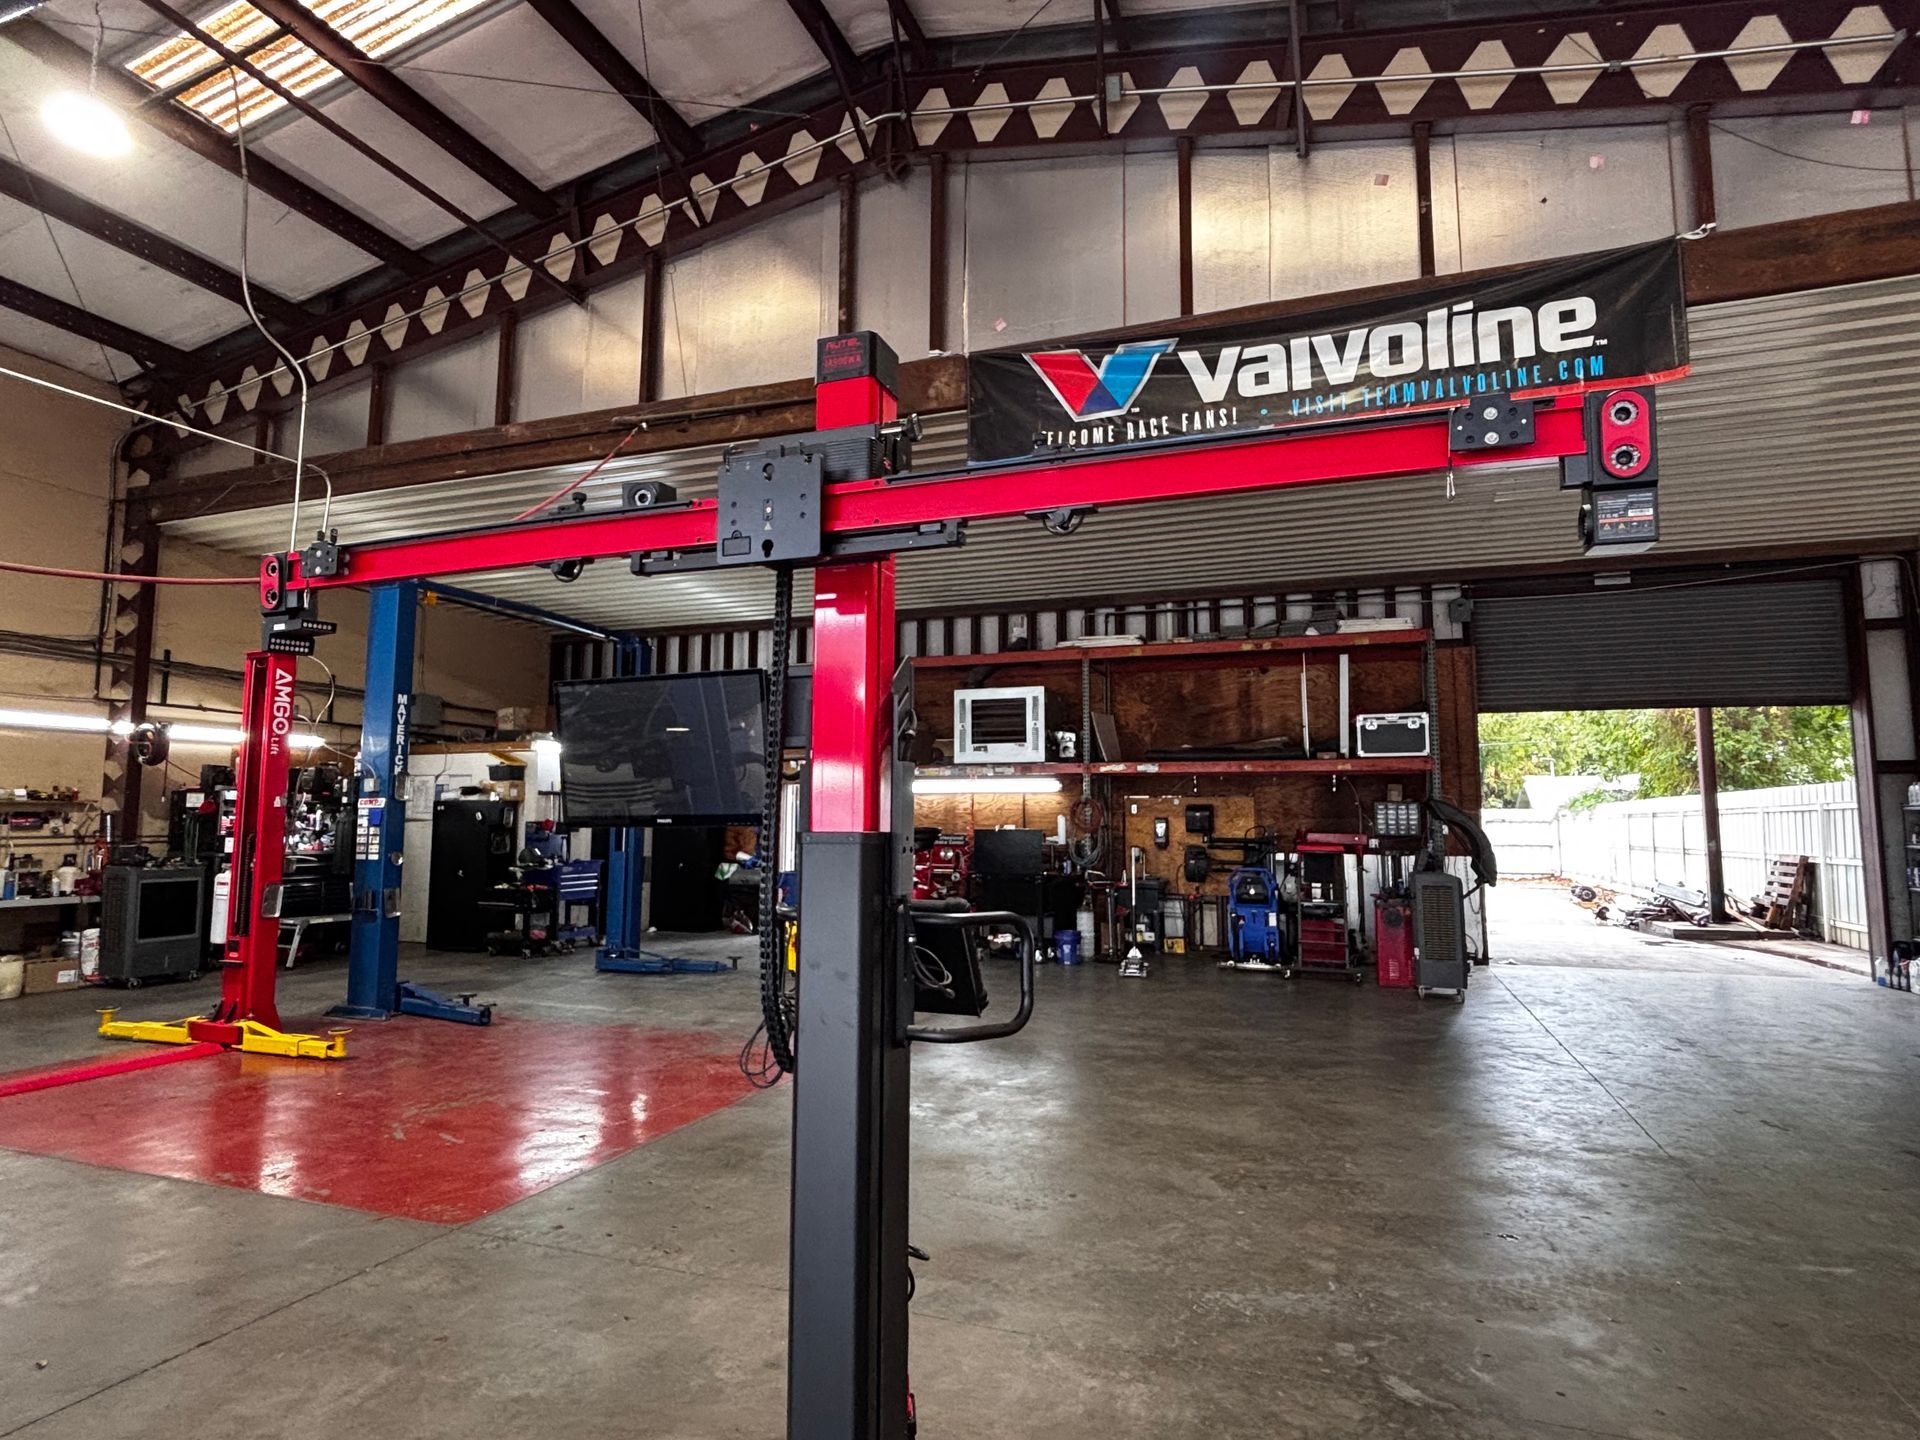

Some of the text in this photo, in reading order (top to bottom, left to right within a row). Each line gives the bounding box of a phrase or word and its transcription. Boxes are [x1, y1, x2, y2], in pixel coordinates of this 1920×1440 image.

[1041, 355, 1605, 446] ELCOME RACE FANS! VISIT TEAMVALVOLINE.COM
[272, 668, 293, 735] AMGO
[394, 693, 408, 775] MAVERICK
